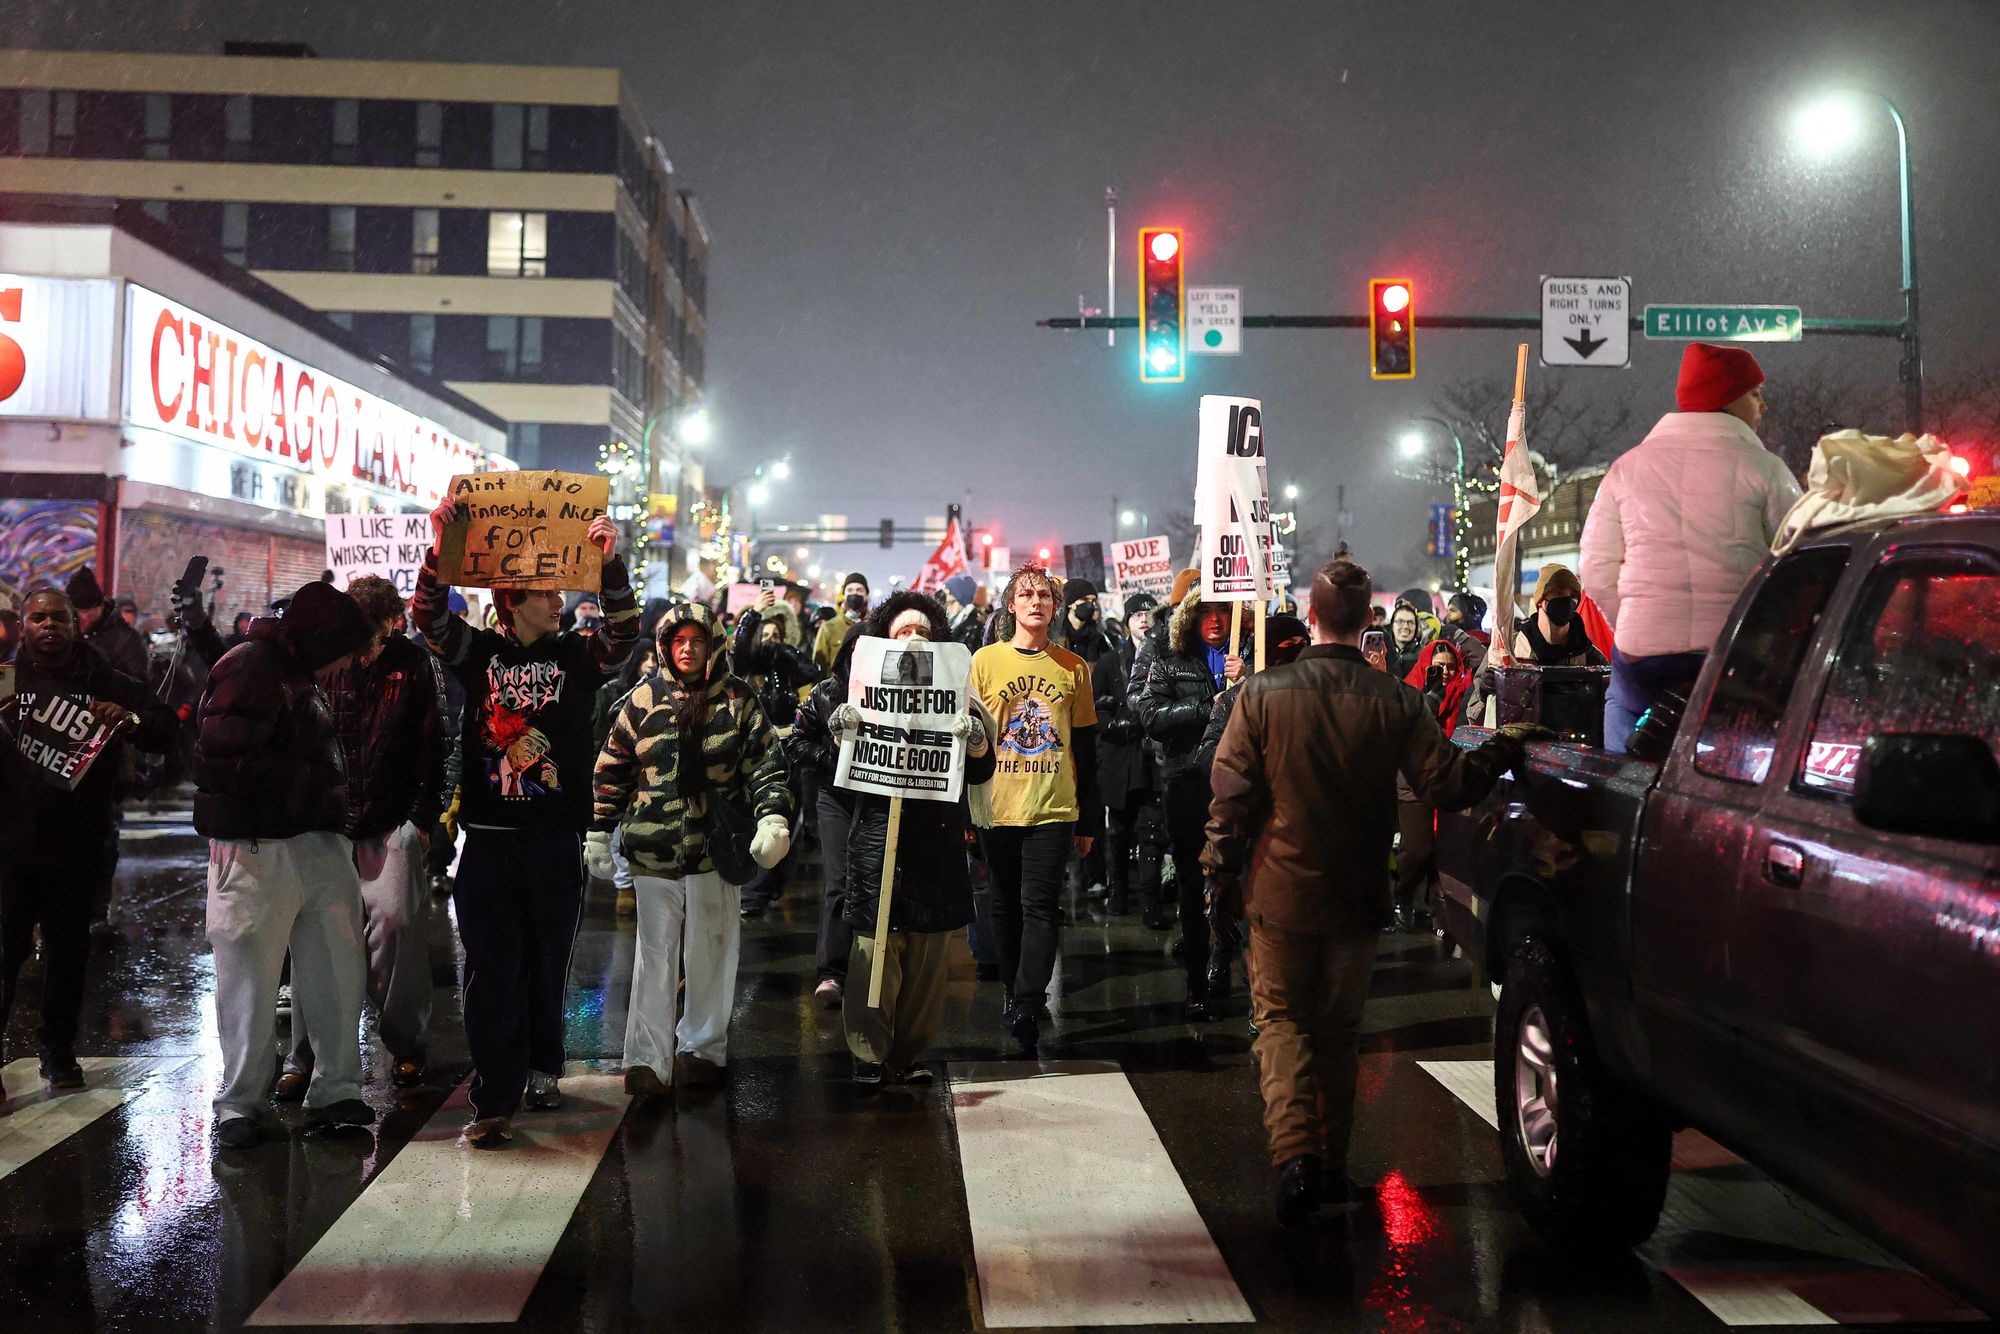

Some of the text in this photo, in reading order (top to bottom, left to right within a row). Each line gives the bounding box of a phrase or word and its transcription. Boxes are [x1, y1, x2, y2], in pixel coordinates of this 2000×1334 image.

[1549, 284, 1622, 295] BUSES AND
[1549, 299, 1622, 311] RIGHT TURNS
[1568, 314, 1603, 326] ONLY
[1657, 313, 1788, 333] Elliot Av S
[150, 307, 340, 471] CHICAGO
[455, 477, 506, 496] Aint
[341, 518, 427, 539] I LIKE MY
[330, 543, 430, 567] WHISKEY NEAT
[1124, 540, 1160, 560] DUE
[464, 545, 582, 578] ICE!!
[860, 685, 957, 715] JUSTICE FOR
[998, 674, 1065, 705] PROTECT
[856, 721, 953, 748] RENEE
[20, 733, 80, 779] RENEE
[851, 739, 951, 774] NICOLE GOOD
[997, 760, 1061, 774] THE DOLLS
[850, 768, 947, 789] PARTY FOR SOCIALISM & LIBERATION
